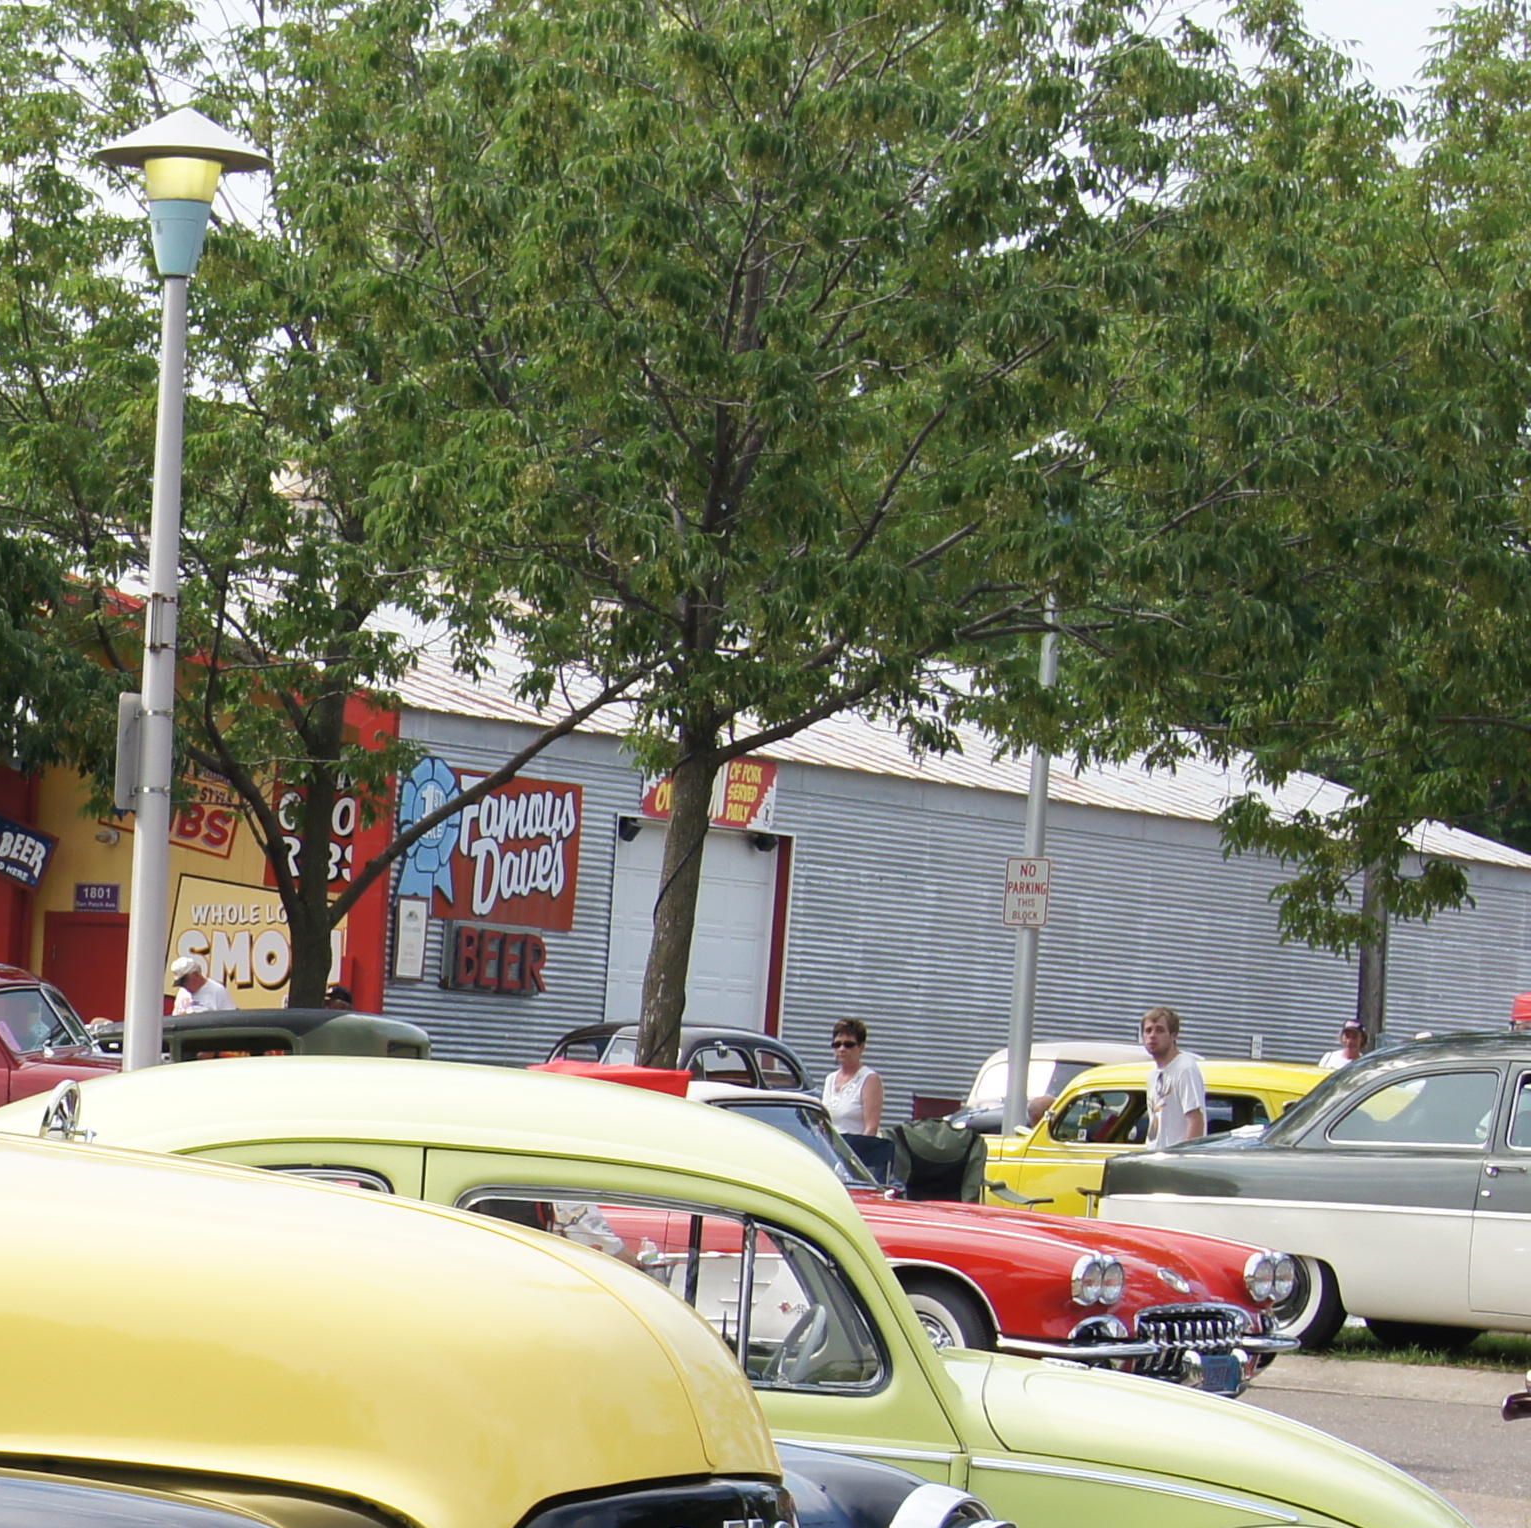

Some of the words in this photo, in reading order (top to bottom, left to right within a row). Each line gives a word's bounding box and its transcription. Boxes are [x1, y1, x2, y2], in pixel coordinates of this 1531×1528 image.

[728, 783, 758, 803] SERVED
[459, 774, 576, 856] Famous
[726, 803, 750, 822] DAILY
[6, 865, 28, 881] HERE
[470, 829, 565, 915] Dave's
[1020, 864, 1037, 877] NO
[83, 887, 110, 899] 1801
[1007, 881, 1047, 895] PARKING
[1017, 898, 1035, 907] THIS
[191, 904, 260, 926] WHOLE
[1012, 910, 1038, 920] BLOCK
[457, 926, 547, 992] BEER
